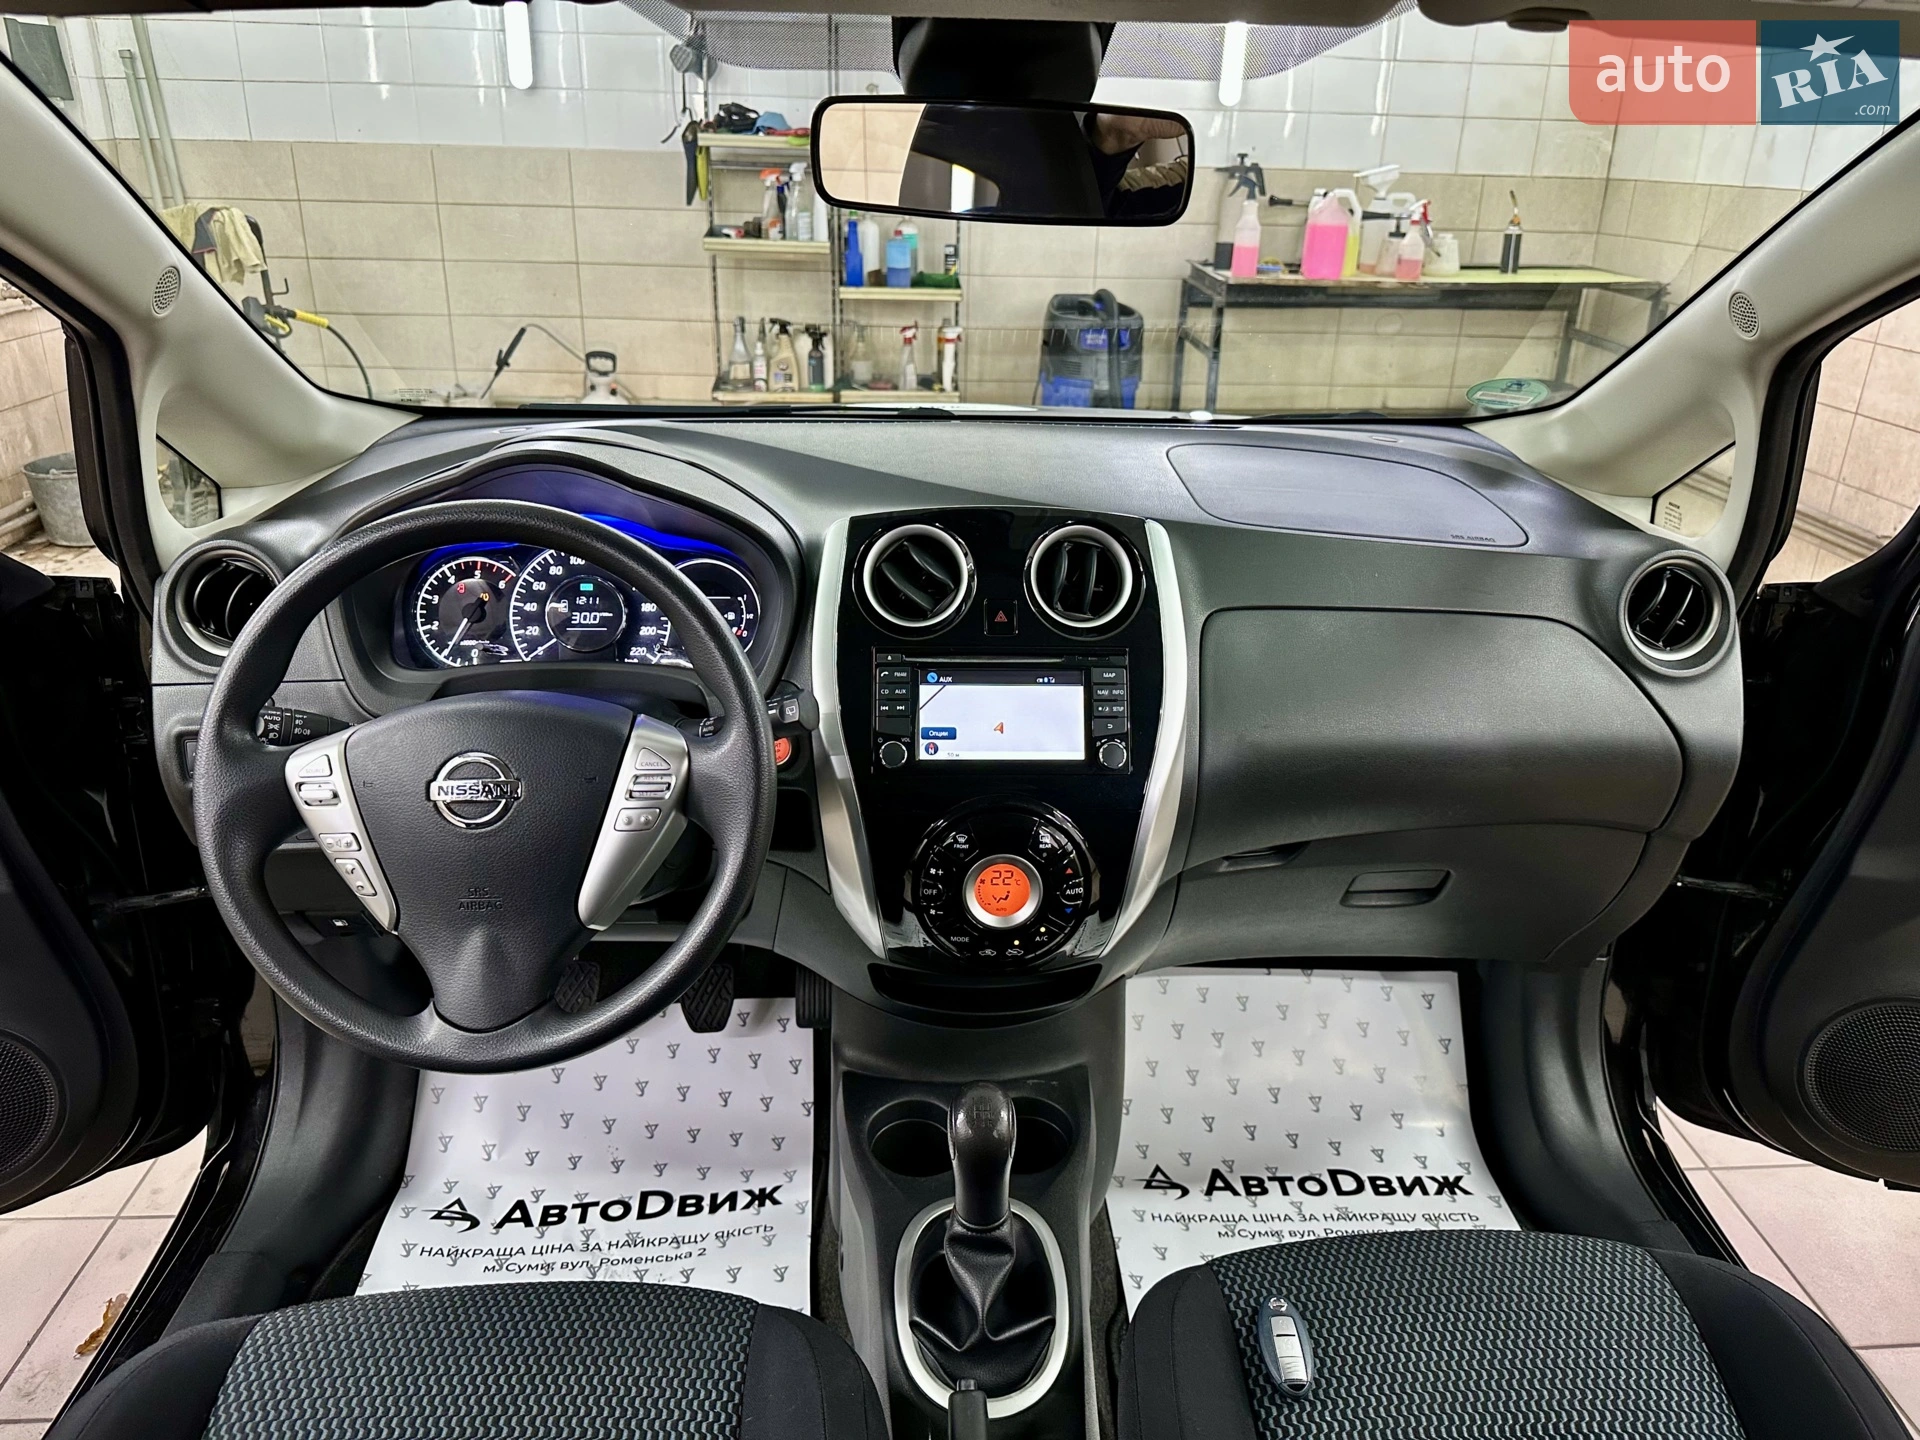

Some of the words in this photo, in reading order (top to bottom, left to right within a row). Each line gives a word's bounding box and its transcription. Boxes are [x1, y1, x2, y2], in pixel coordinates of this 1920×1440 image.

[474, 570, 481, 579] 5
[549, 566, 563, 575] 80
[448, 575, 455, 584] 4
[499, 581, 506, 589] 6
[532, 581, 546, 590] 60
[431, 595, 439, 604] 3
[523, 602, 537, 611] 40
[641, 602, 657, 612] 180
[571, 612, 600, 624] 30.0
[430, 621, 438, 630] 2
[525, 626, 539, 635] 20
[639, 626, 657, 635] 200
[471, 649, 479, 657] 0
[629, 647, 647, 656] 220
[437, 783, 512, 797] NISSAN
[990, 870, 1014, 886] 22
[467, 888, 490, 897] SRS
[923, 888, 938, 896] OFF
[1065, 887, 1084, 895] AUTO
[458, 901, 503, 912] AIRBAG
[1150, 1211, 1248, 1224] НАЙКРАЩА
[1253, 1212, 1294, 1224] ЦІНА
[1298, 1212, 1320, 1223] ЗА
[1323, 1212, 1417, 1223] НАЙКРАЩУ
[1421, 1212, 1480, 1223] ЯКІСТЬ
[1289, 1229, 1320, 1240] вул.
[419, 1246, 526, 1259] НАЙКРАЩА
[531, 1243, 575, 1256] ЦІНА
[579, 1242, 602, 1252] ЗА
[607, 1232, 710, 1250] НАЙКРАЩУ
[714, 1223, 775, 1240] ЯКІСТЬ
[560, 1259, 594, 1271] вул.
[600, 1250, 693, 1267] Роменська
[697, 1247, 707, 1257] 2
